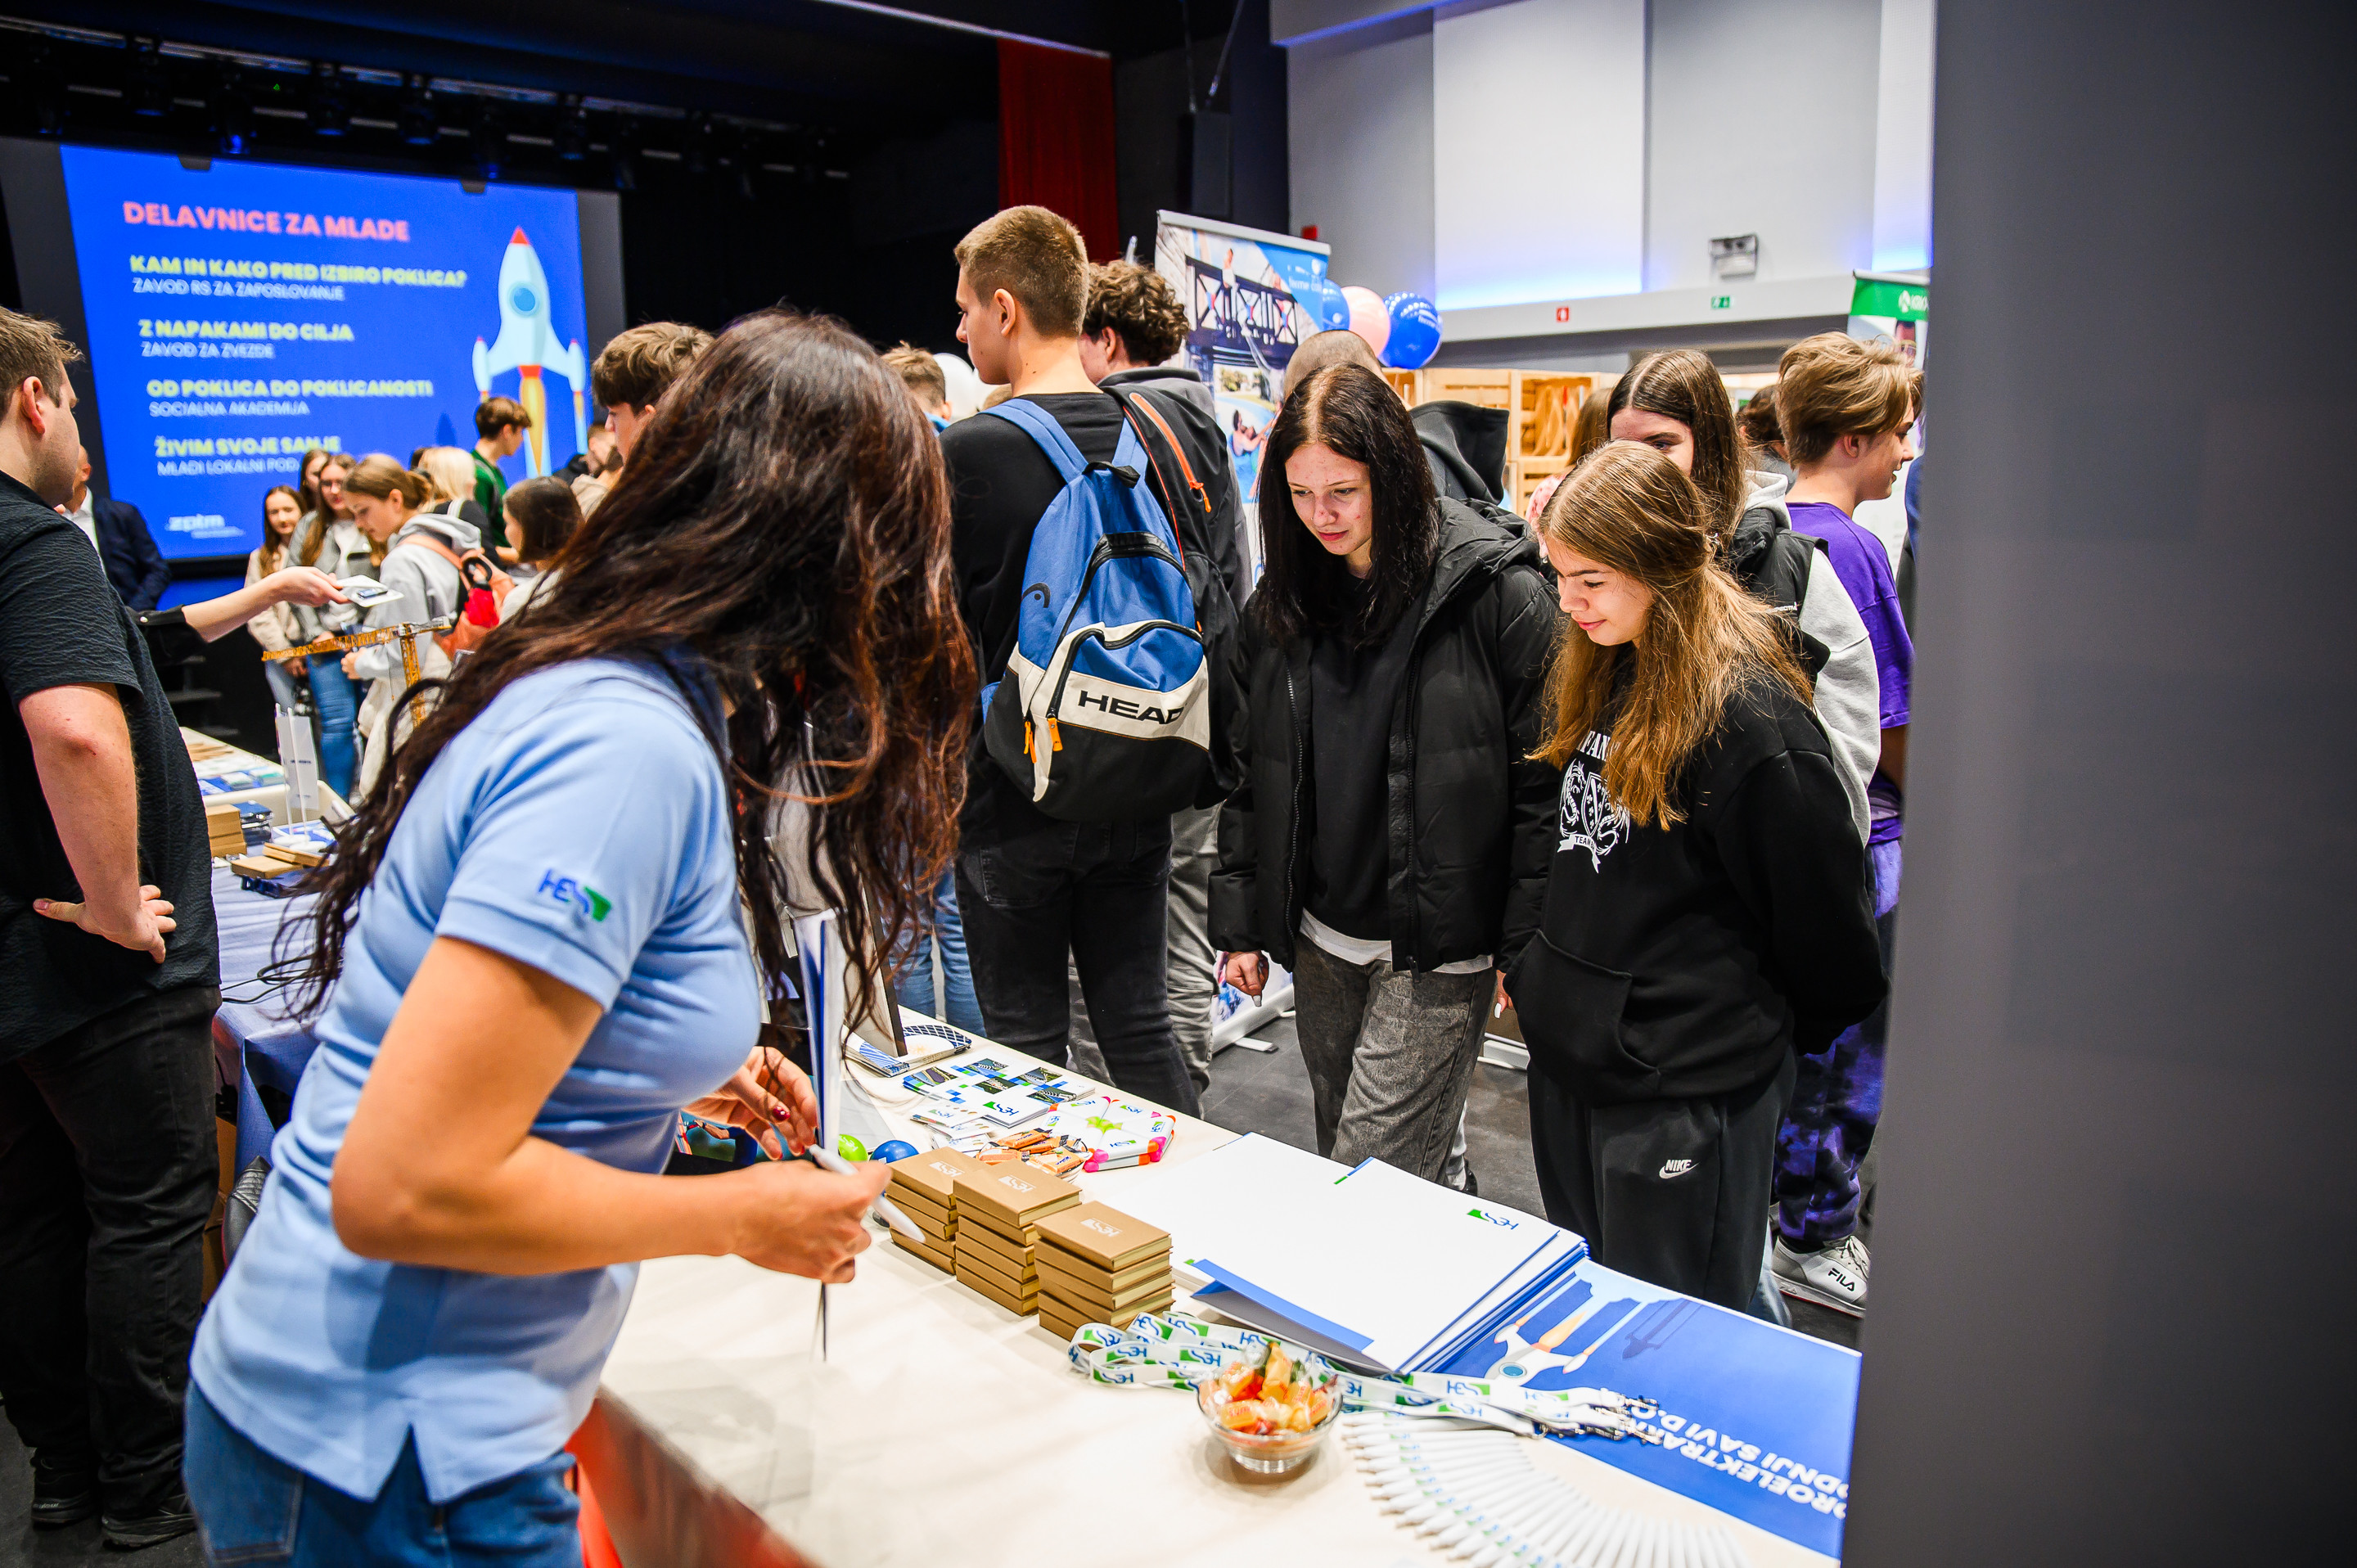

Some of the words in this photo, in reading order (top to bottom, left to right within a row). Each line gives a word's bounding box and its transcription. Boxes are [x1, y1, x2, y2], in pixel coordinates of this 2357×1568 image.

[123, 201, 282, 234] DELAVNICE
[284, 212, 322, 236] ZA
[323, 215, 410, 241] MLADE
[129, 255, 182, 275] KAM
[183, 258, 207, 277] IN
[208, 258, 268, 279] KAKO
[269, 260, 318, 281] PRED
[319, 264, 381, 284] IZBIRO
[381, 267, 468, 288] POKLICA?
[133, 277, 190, 295] ZAVOD
[213, 280, 235, 297] ZA
[138, 318, 154, 337] Z
[155, 319, 268, 340] NAPAKAMI
[268, 322, 299, 340] DO
[300, 322, 354, 342] CILJA
[141, 340, 197, 358] ZAVOD
[198, 341, 220, 358] ZA
[146, 379, 180, 398] OD
[181, 379, 270, 398] POKLICA
[270, 379, 300, 398] DO
[301, 379, 434, 398] POKLICANOSTI
[149, 401, 228, 417] SOCIALNA
[228, 400, 310, 416] AKADEMIJA
[154, 435, 214, 457] ŽIVIM
[215, 436, 278, 456] SVOJE
[205, 458, 264, 475] LOKALNI
[1078, 690, 1184, 724] HEAD
[1665, 1159, 1692, 1172] NIKE
[1827, 1268, 1855, 1292] FILA
[1684, 1422, 1762, 1462] SAVI
